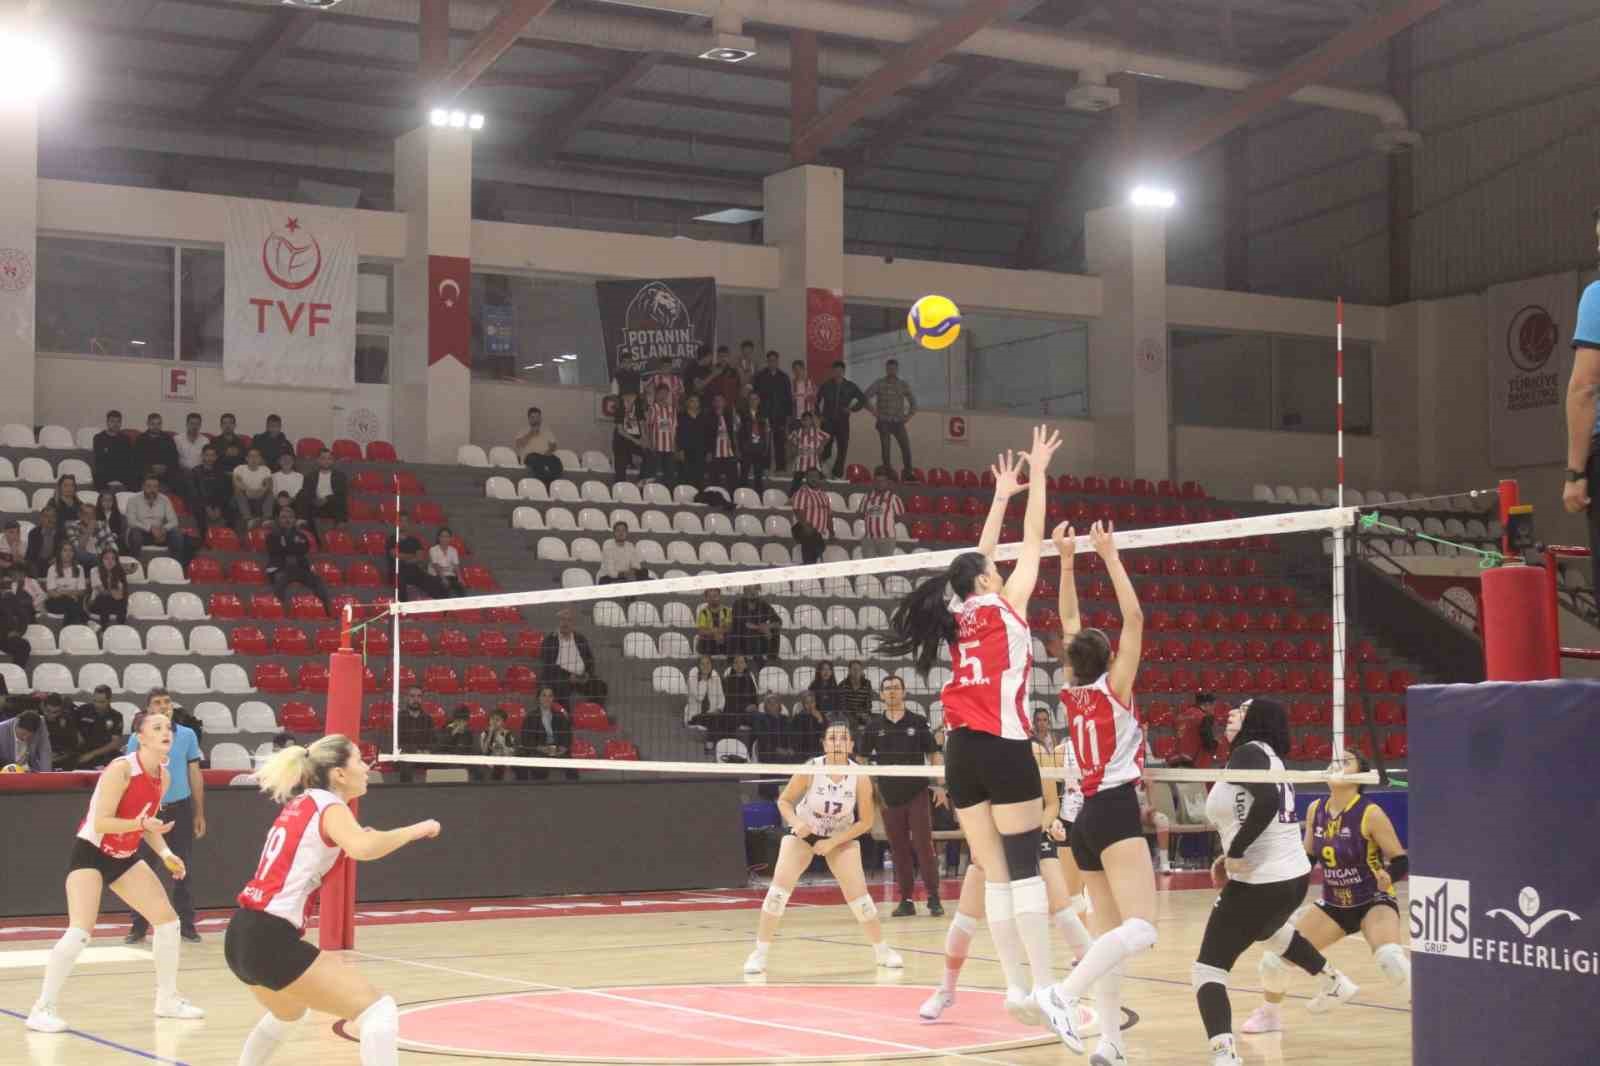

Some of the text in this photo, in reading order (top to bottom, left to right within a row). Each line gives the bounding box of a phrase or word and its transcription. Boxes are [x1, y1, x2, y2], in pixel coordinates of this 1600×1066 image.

[249, 298, 332, 337] TVF
[170, 369, 187, 393] F
[949, 416, 965, 437] G
[958, 640, 983, 684] 5
[1073, 714, 1100, 767] 11
[824, 800, 843, 815] 17
[255, 826, 287, 881] 19
[1322, 846, 1337, 868] 9
[1410, 881, 1468, 944] SMS
